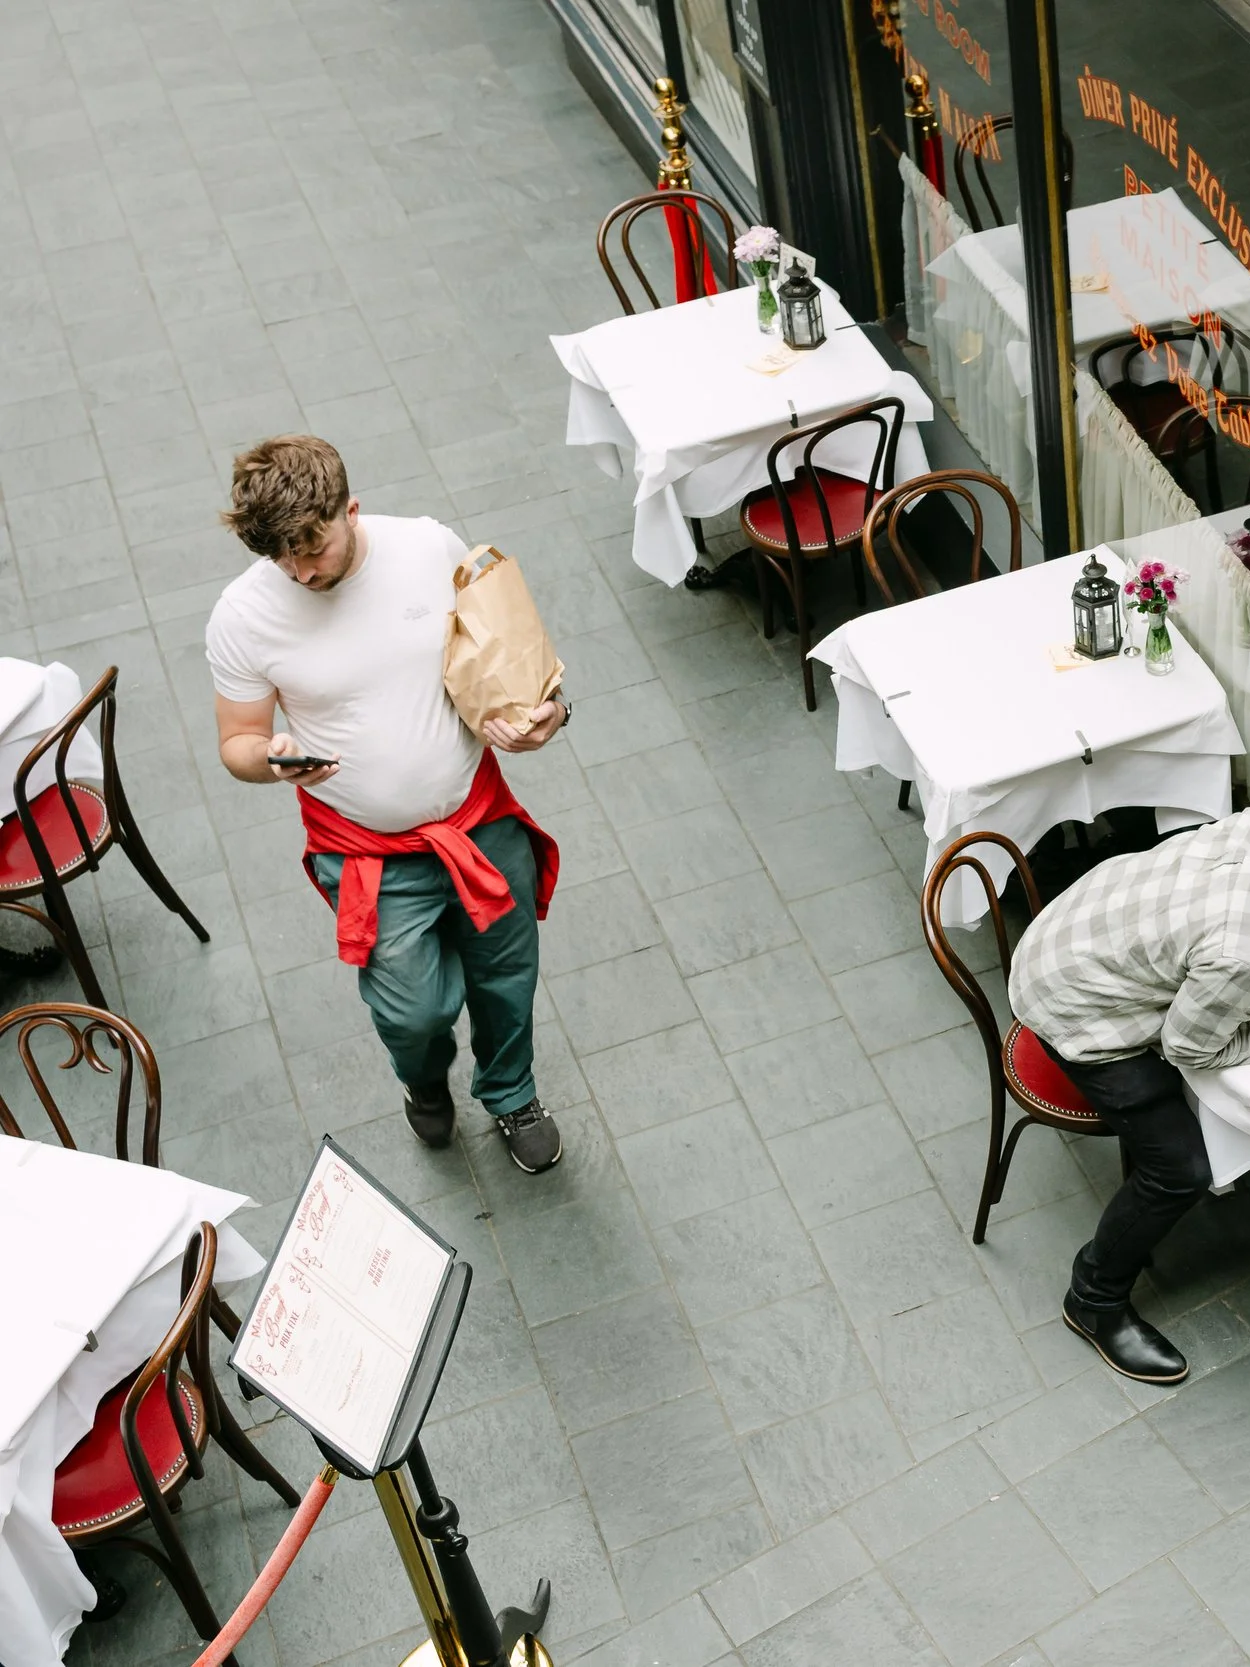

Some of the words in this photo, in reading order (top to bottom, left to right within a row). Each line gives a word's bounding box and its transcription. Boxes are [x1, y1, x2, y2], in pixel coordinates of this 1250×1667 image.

[1077, 63, 1126, 128] DÎNER
[1129, 91, 1179, 169] PRIVÉ
[1124, 163, 1209, 283] PETITE
[1120, 215, 1221, 351] MAISON
[280, 1330, 293, 1348] PRIX
[287, 1310, 300, 1330] FIXE
